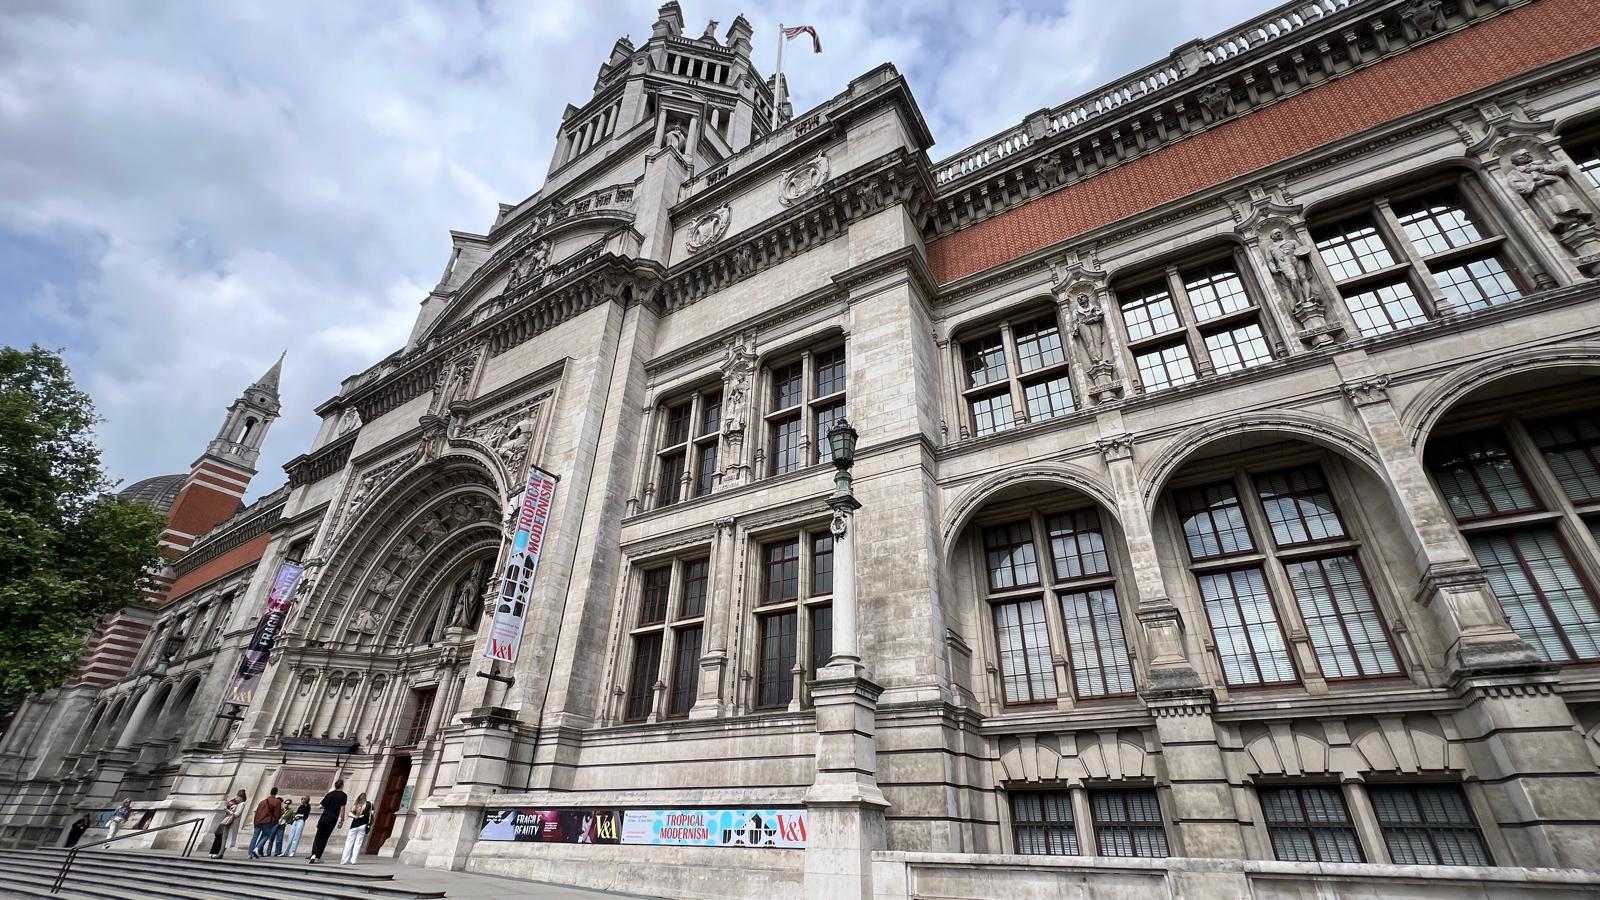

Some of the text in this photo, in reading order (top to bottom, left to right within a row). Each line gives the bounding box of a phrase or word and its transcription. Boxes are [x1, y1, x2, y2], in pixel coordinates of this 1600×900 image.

[518, 475, 542, 532] TROPICAL
[528, 479, 554, 554] MODERNISM
[492, 638, 512, 660] V&A
[596, 815, 618, 839] V&A
[666, 814, 705, 827] TROPICAL
[776, 815, 806, 841] V&A
[659, 828, 709, 840] MODERNISM
